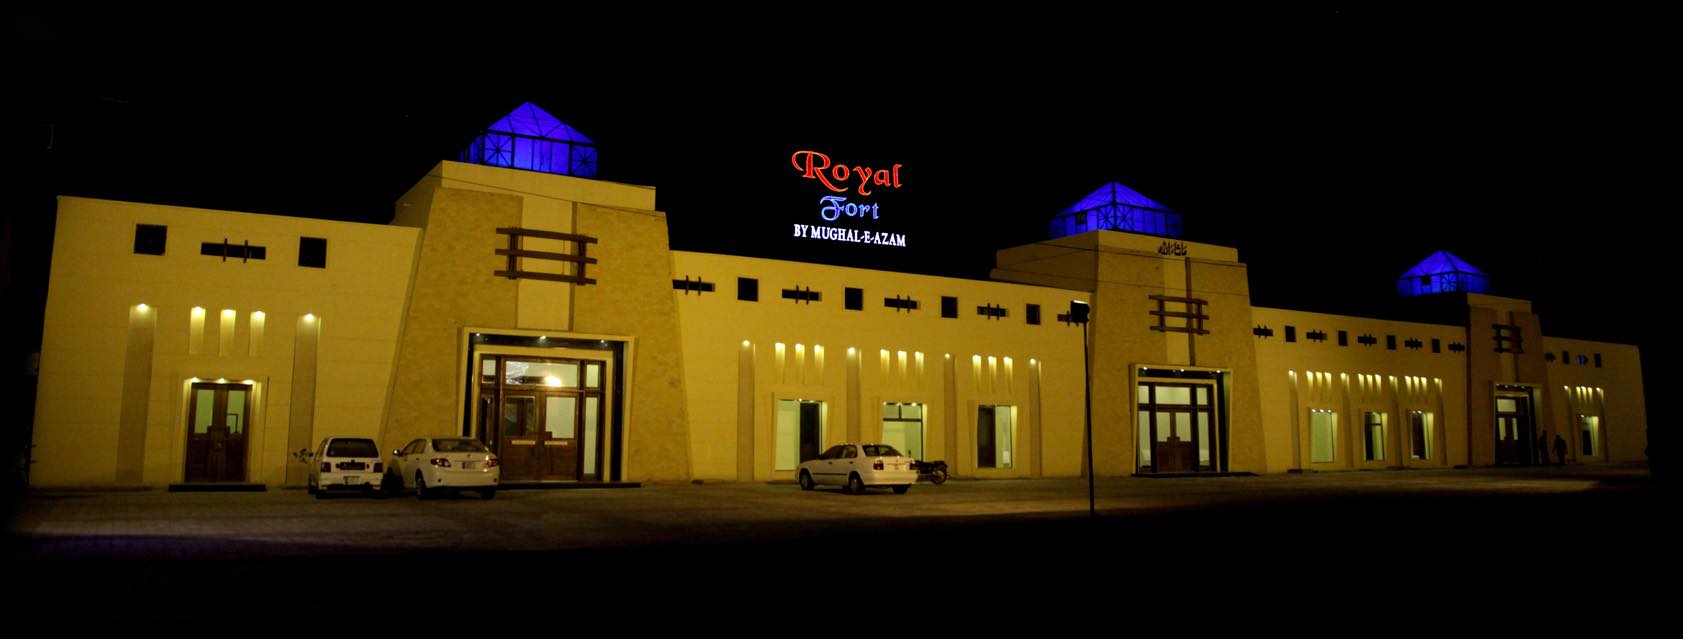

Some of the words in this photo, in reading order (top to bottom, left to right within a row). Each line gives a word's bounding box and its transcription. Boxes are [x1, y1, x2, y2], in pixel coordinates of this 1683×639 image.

[792, 150, 902, 196] Royal
[820, 195, 879, 221] Fort
[794, 224, 808, 238] BY
[811, 225, 906, 247] MUGHAL-E-AZAM
